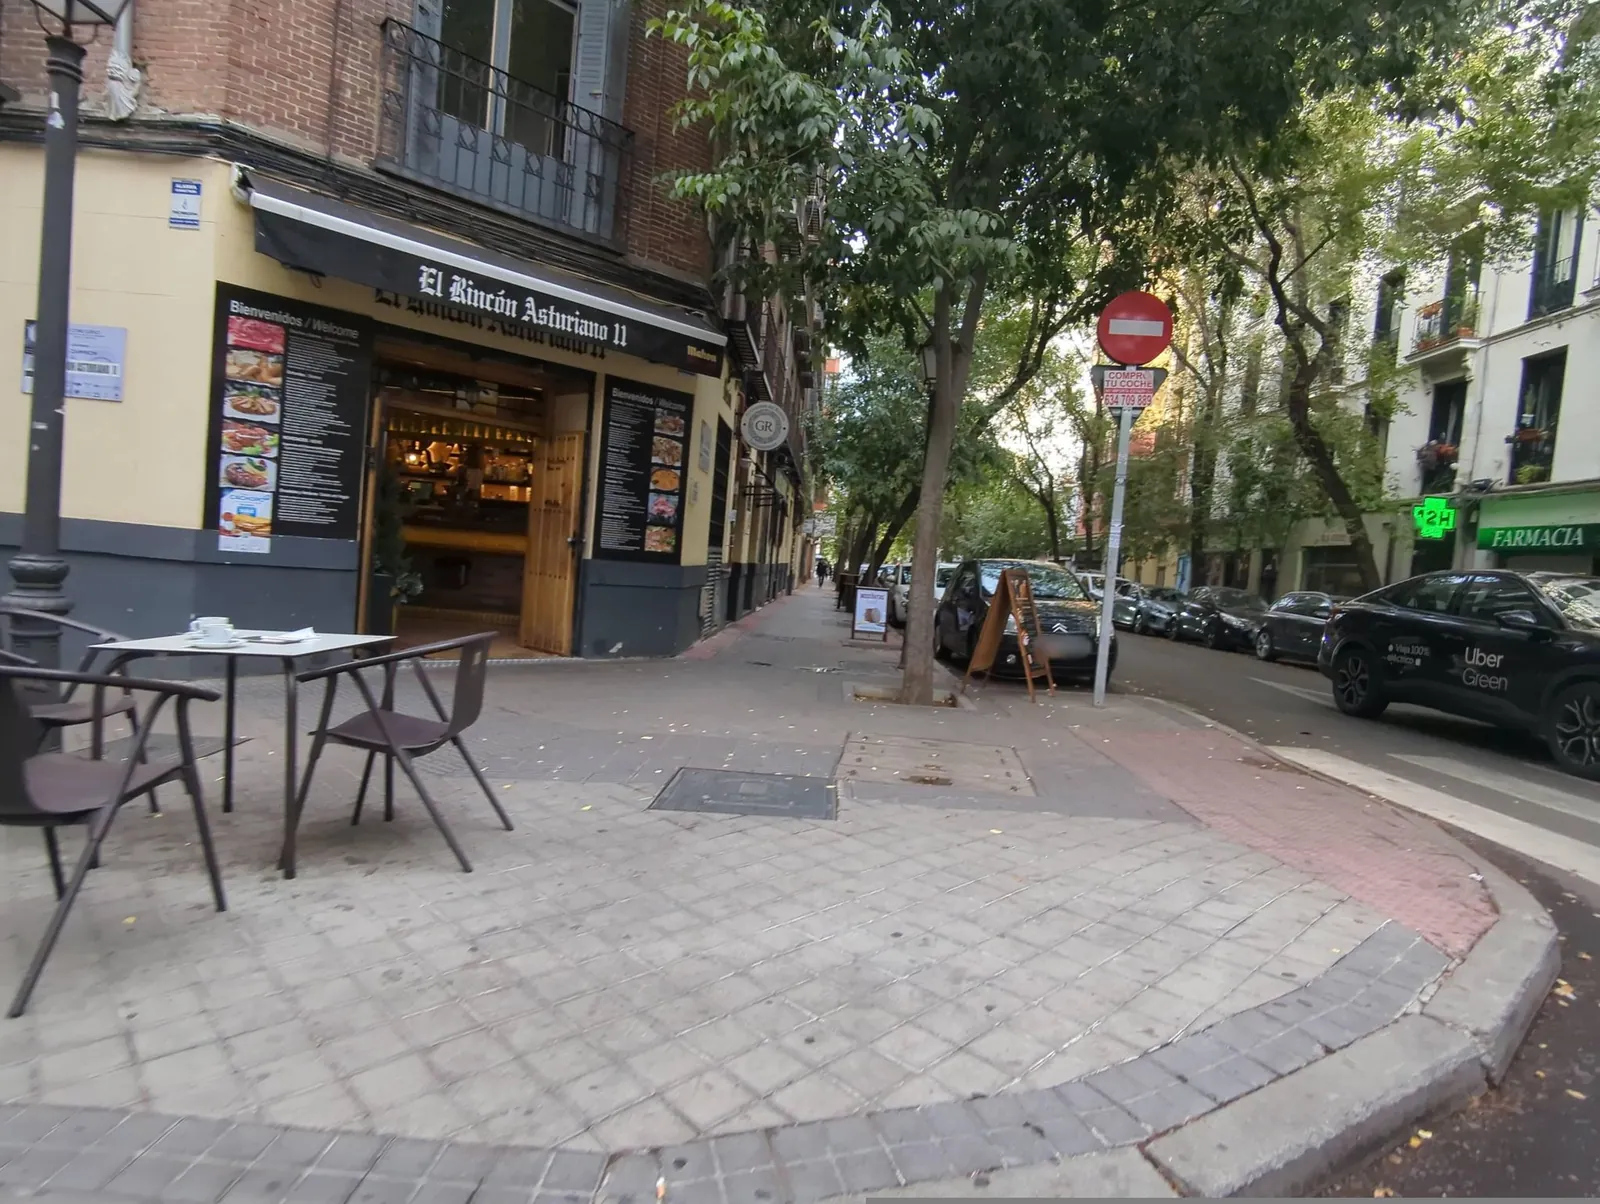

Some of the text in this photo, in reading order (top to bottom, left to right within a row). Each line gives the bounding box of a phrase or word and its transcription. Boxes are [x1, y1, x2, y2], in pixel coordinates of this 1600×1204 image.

[419, 265, 444, 297] El
[449, 275, 518, 318] Rincón
[521, 297, 608, 341] Asturiano
[230, 300, 303, 327] Bienvenidos
[313, 320, 359, 339] Welcome
[1108, 371, 1150, 379] COMPR
[1120, 380, 1152, 388] COCHE
[612, 387, 654, 405] Bienvenidos
[755, 420, 773, 432] GR
[1492, 527, 1584, 547] FARMACIA
[1465, 646, 1504, 668] Uber
[1462, 667, 1508, 691] Green
